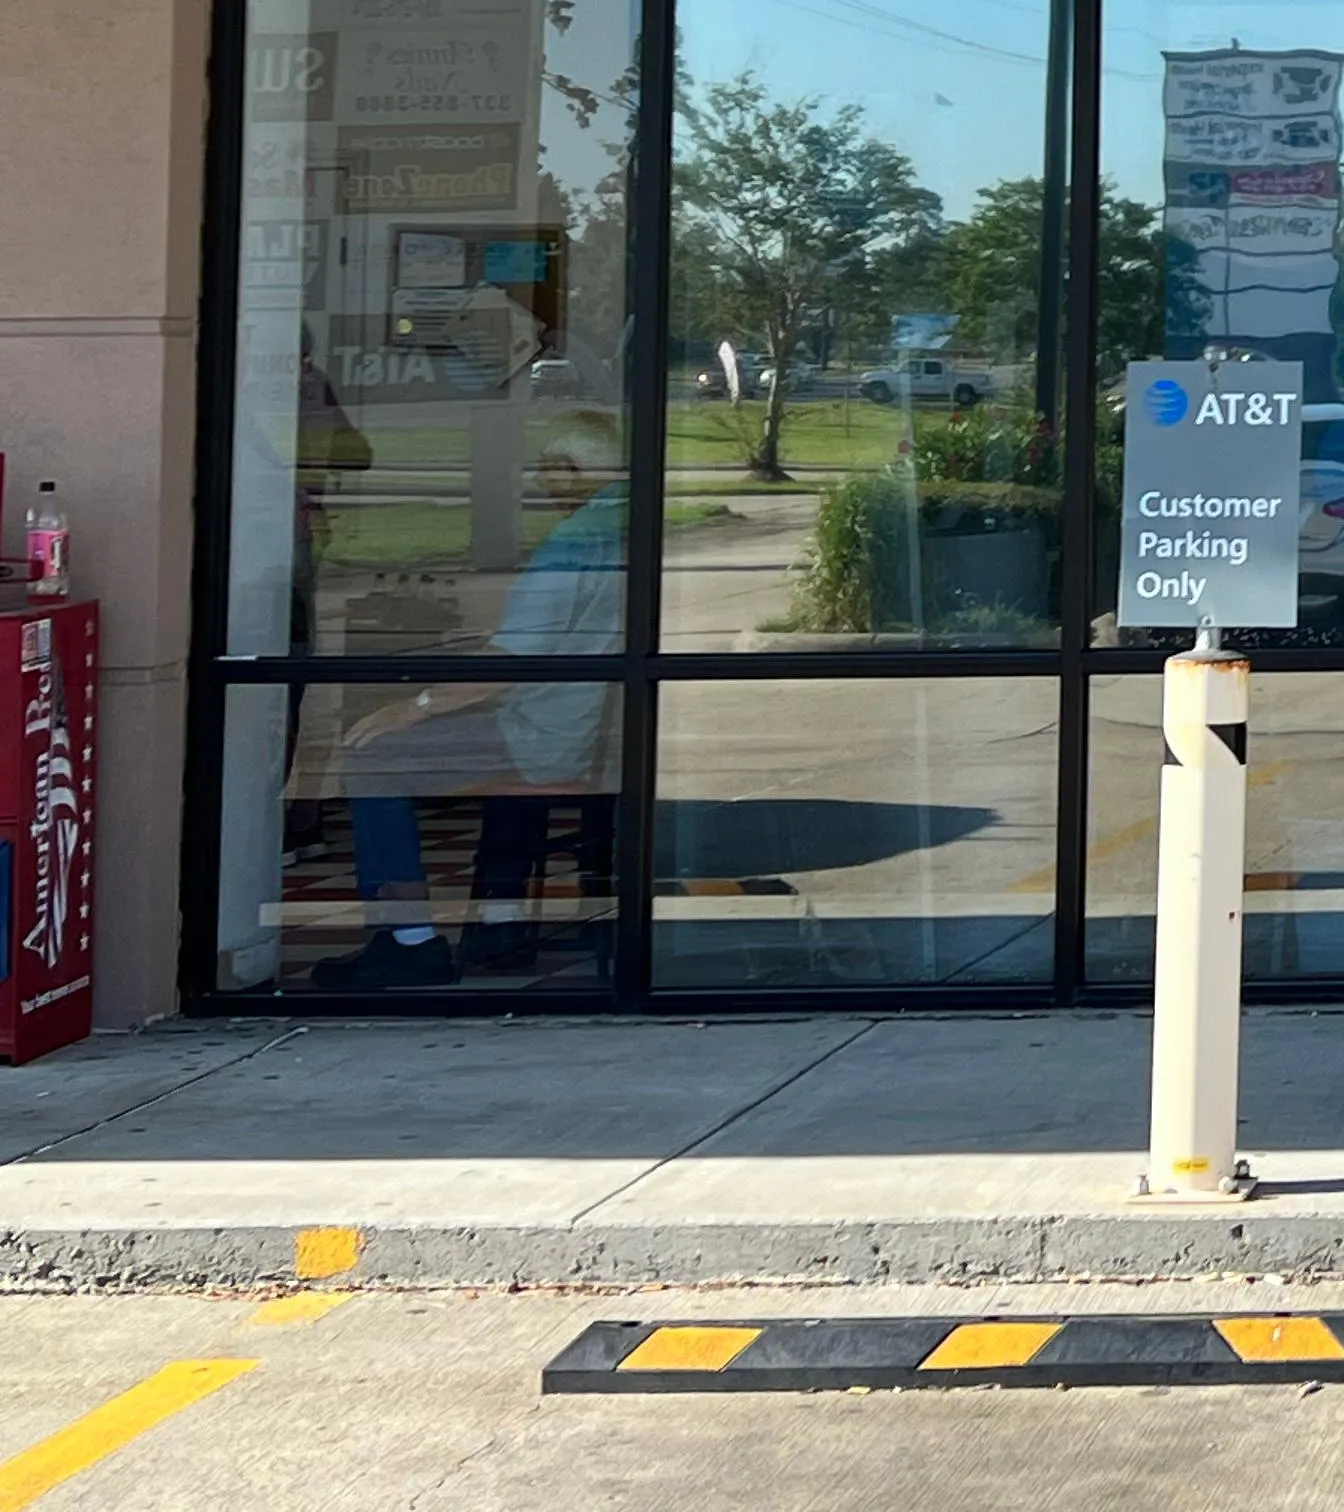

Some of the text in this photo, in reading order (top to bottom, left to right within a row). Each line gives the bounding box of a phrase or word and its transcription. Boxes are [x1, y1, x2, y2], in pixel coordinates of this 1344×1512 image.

[1194, 392, 1298, 426] AT&T
[1139, 491, 1282, 519] Customer
[1138, 530, 1249, 565] Parking
[1136, 571, 1207, 605] Only
